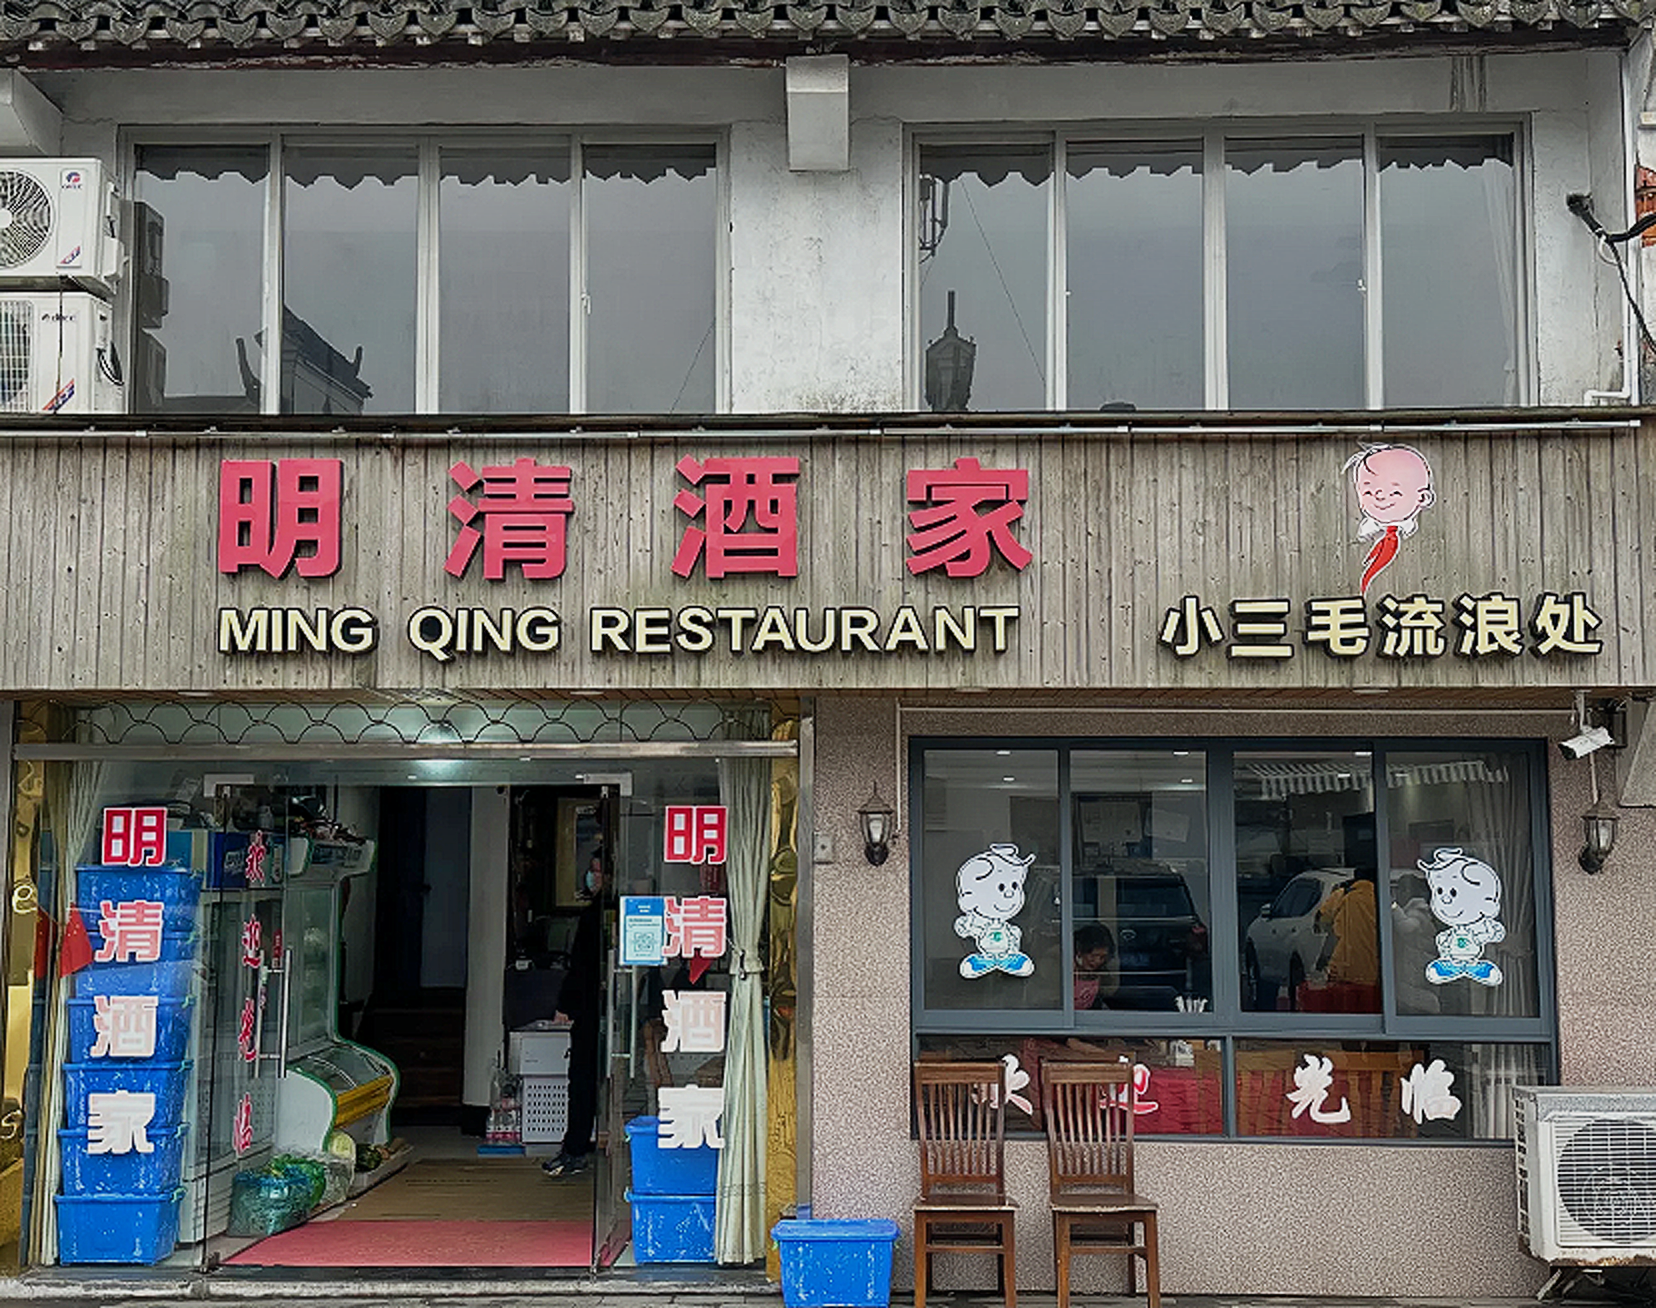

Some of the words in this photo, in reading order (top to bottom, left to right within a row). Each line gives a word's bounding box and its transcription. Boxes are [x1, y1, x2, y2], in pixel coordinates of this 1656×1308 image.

[218, 455, 1034, 581] 明清酒家
[217, 606, 378, 654] MING
[407, 606, 562, 661] QING
[590, 605, 1020, 654] RESTAURANT
[1160, 593, 1603, 658] 小三毛流浪处
[87, 806, 168, 1155] 明清酒家
[658, 804, 728, 1150] 明清酒家
